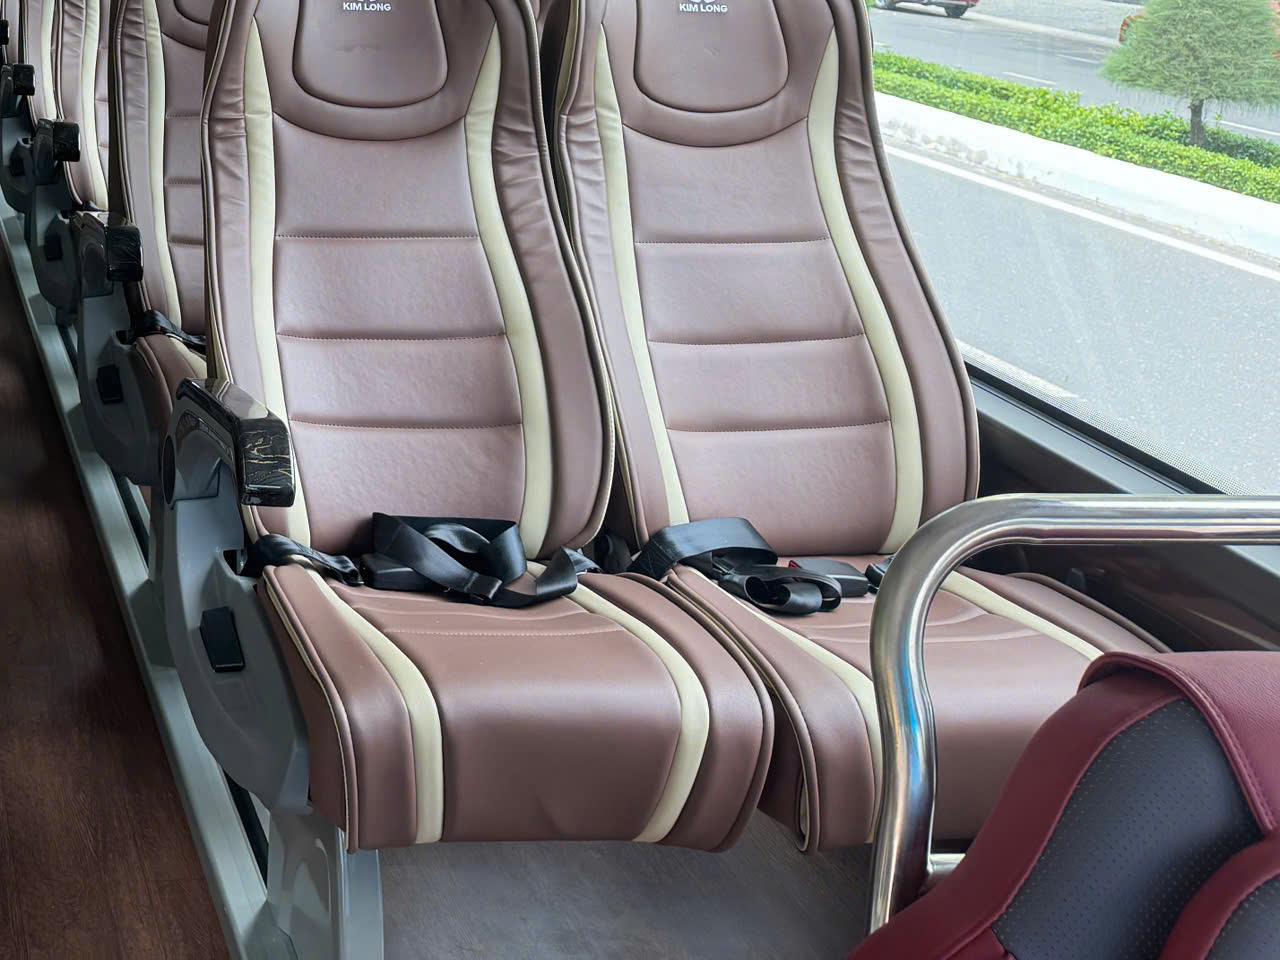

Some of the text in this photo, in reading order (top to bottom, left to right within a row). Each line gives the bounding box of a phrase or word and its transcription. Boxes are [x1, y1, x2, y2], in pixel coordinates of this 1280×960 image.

[343, 2, 392, 12] KIM LONG
[679, 3, 729, 13] KIM LONG
